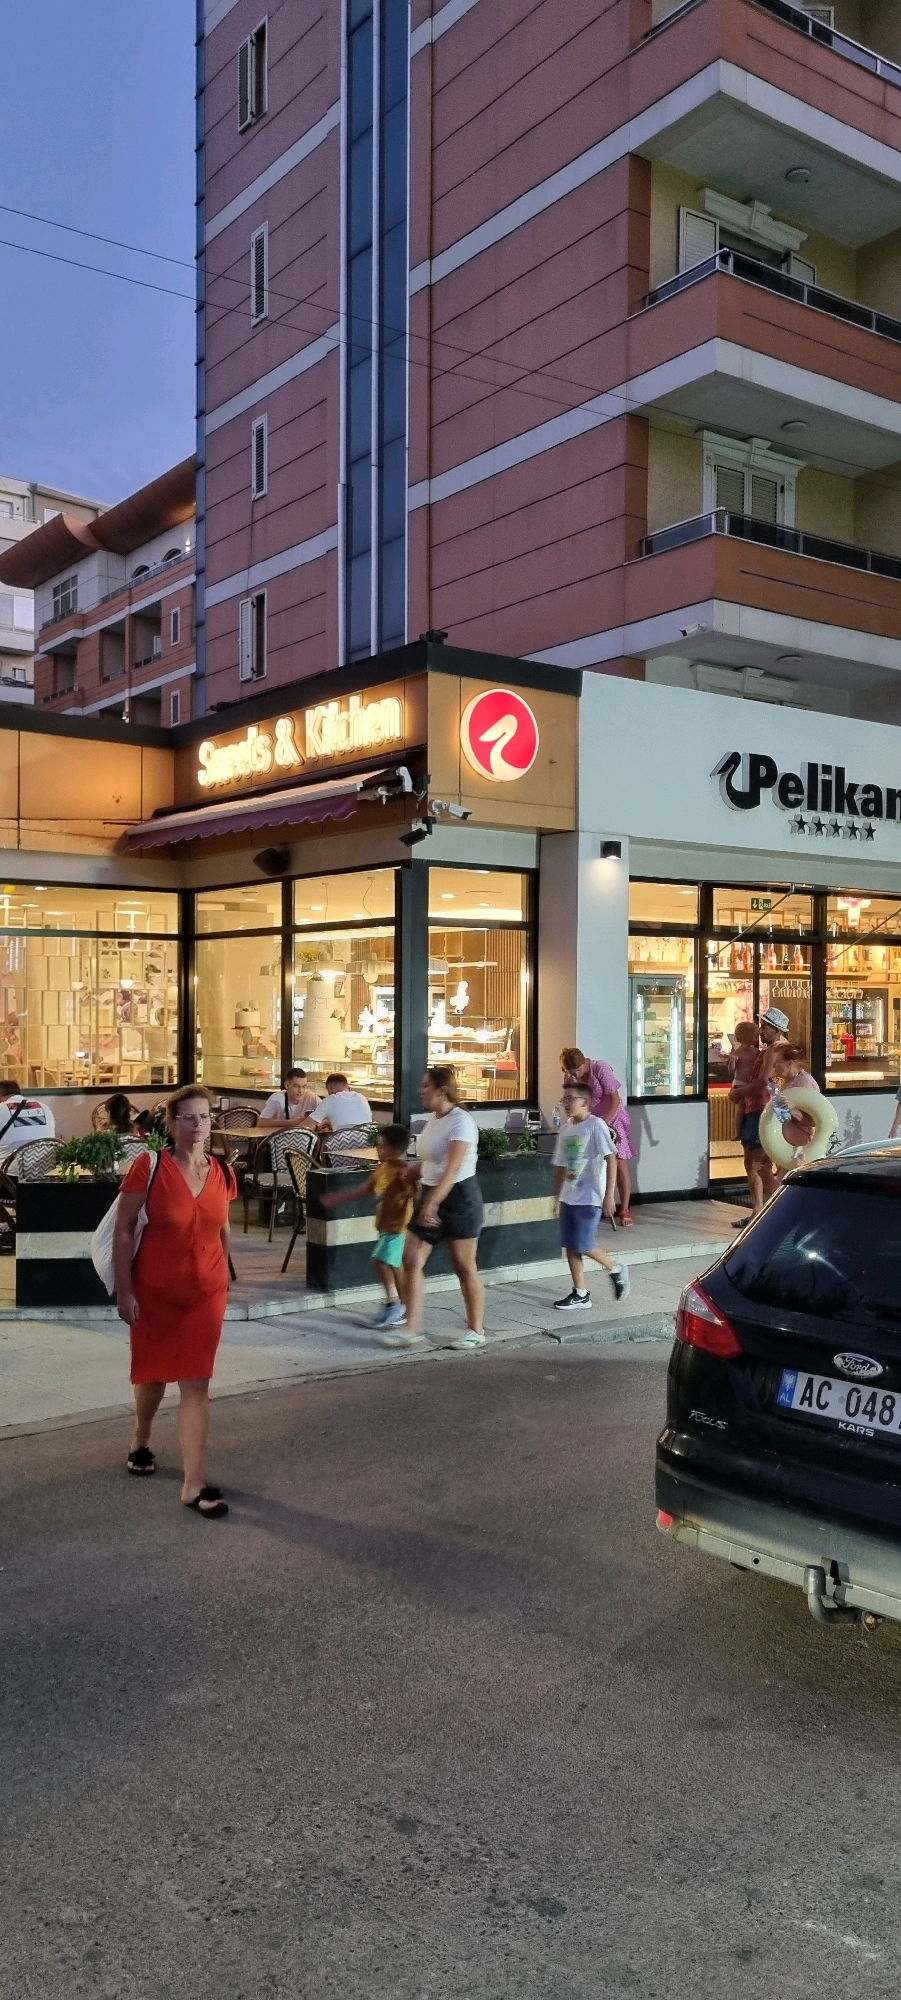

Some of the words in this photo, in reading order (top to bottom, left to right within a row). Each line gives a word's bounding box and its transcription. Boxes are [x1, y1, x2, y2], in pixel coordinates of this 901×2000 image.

[198, 726, 274, 789] Sweets
[275, 716, 304, 769] &
[305, 694, 404, 763] Kitchen
[840, 1356, 878, 1375] Ford
[780, 1394, 791, 1403] AL
[799, 1377, 832, 1411] AC
[845, 1387, 901, 1429] 048
[838, 1421, 875, 1437] KARS
